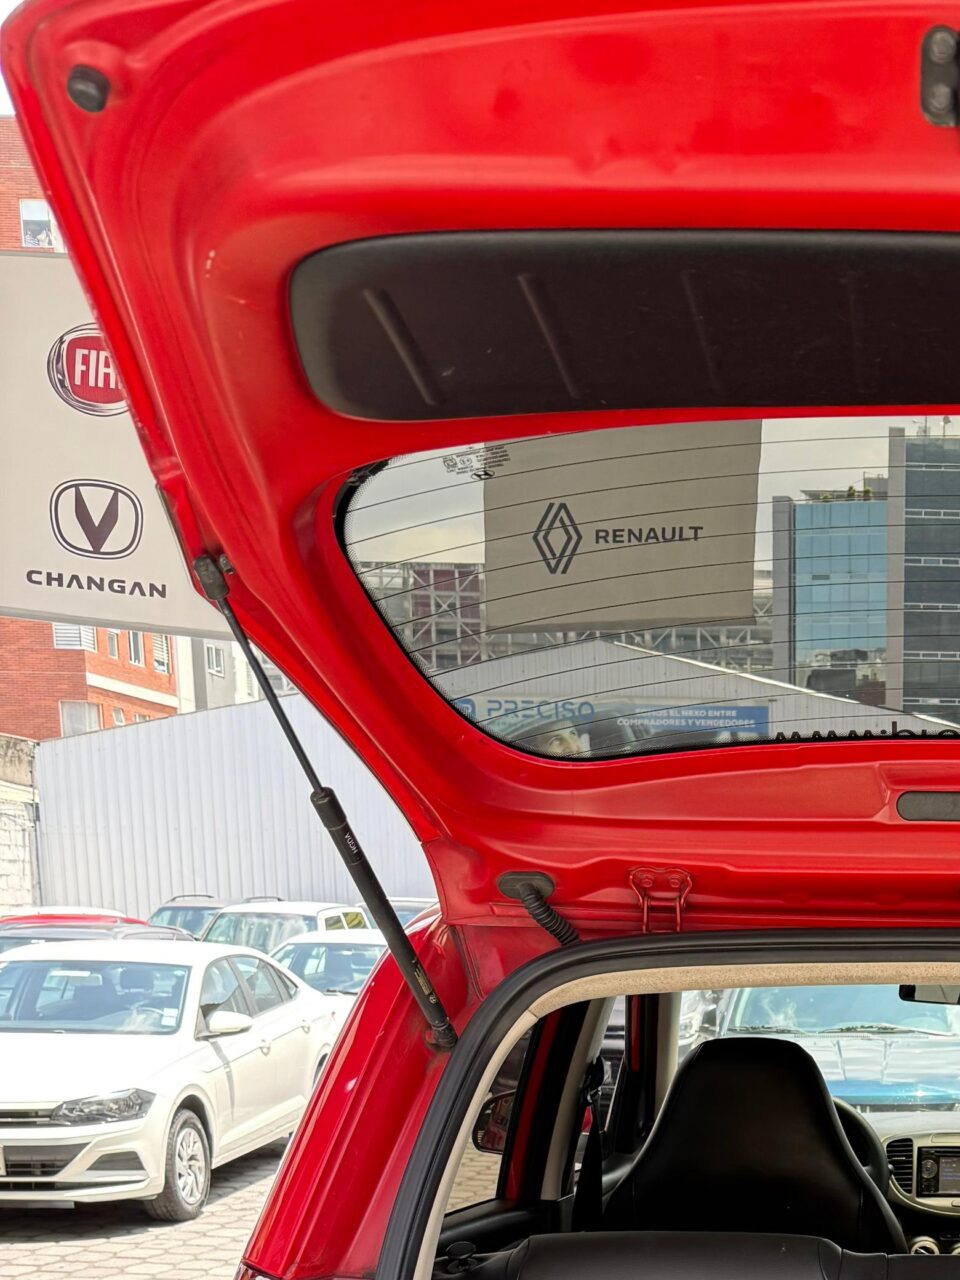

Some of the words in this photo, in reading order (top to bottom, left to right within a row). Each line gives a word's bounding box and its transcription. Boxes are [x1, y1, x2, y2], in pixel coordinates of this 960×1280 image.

[74, 349, 124, 389] FIA
[595, 526, 703, 544] RENAULT
[26, 569, 167, 599] CHANGAN
[487, 699, 595, 721] PRECISO
[708, 709, 738, 718] ENTRE
